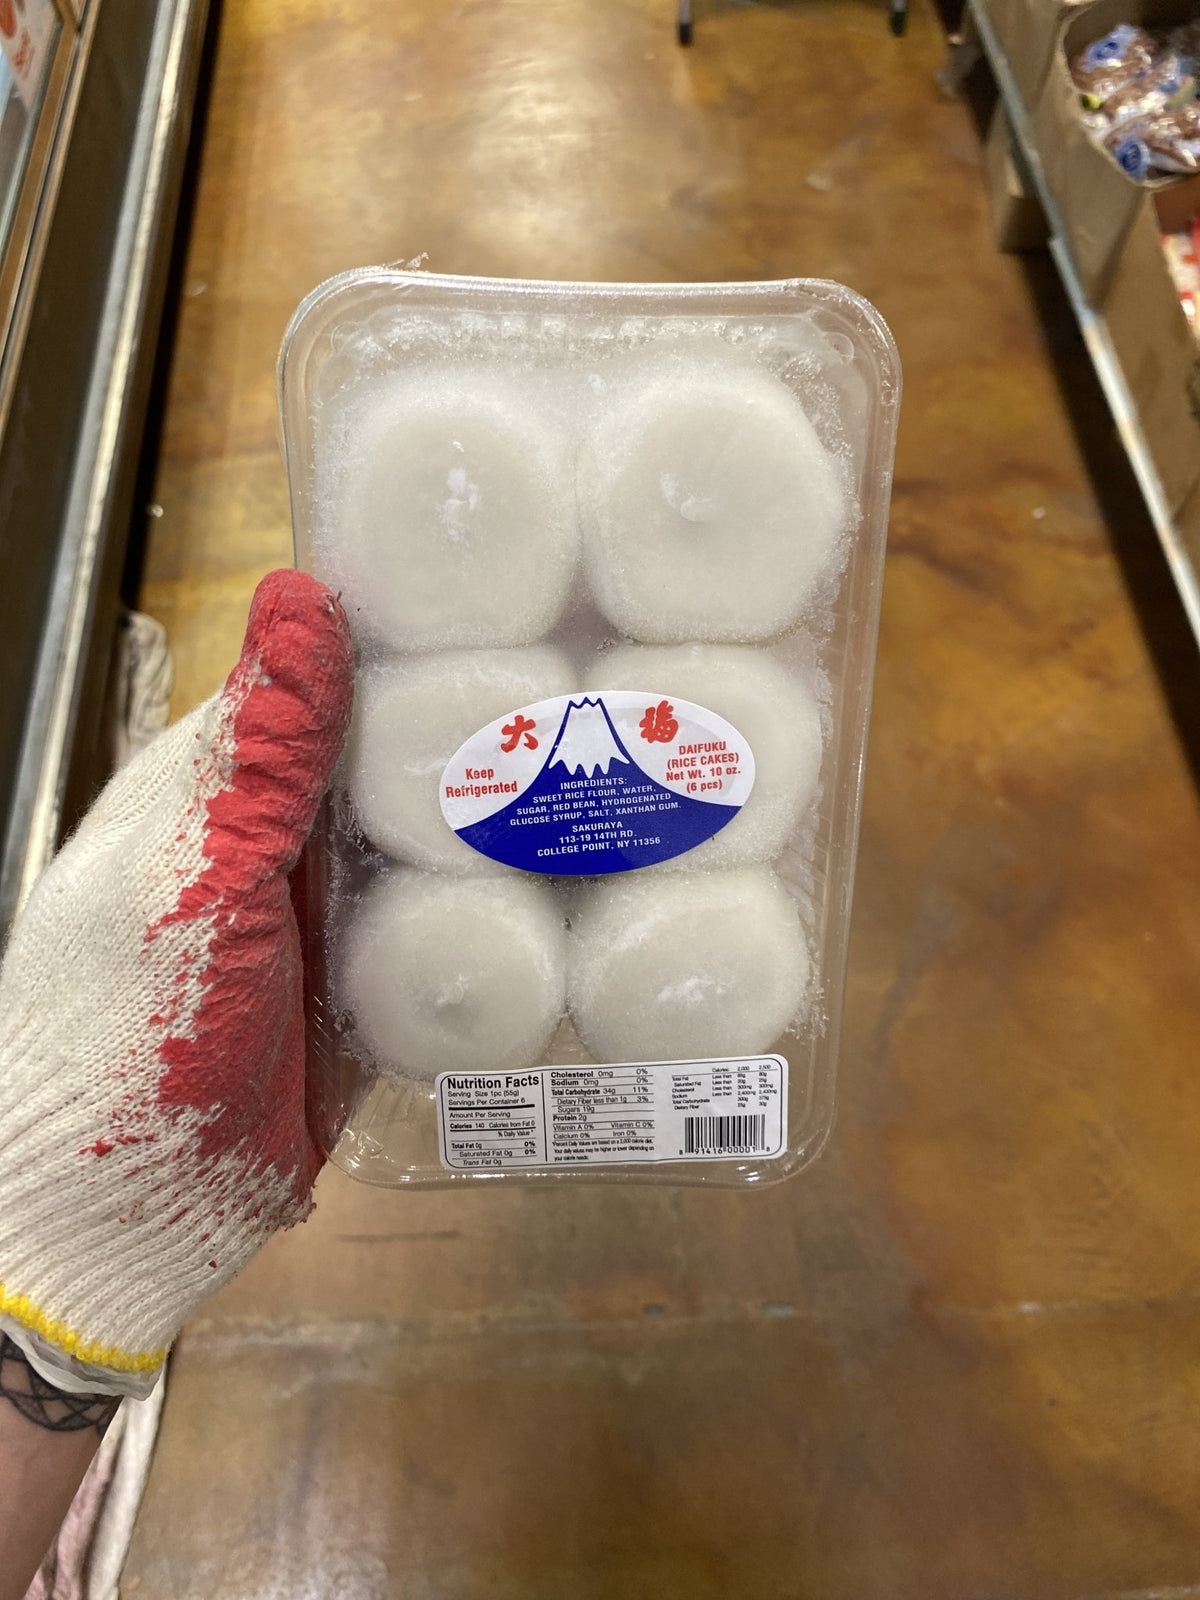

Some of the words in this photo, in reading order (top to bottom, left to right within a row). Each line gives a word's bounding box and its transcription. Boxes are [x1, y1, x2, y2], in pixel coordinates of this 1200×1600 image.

[500, 714, 539, 753] 大
[639, 700, 679, 743] 福
[679, 741, 727, 755] DAIFUKU
[667, 758, 697, 771] (RICE
[700, 752, 740, 765] CAKES)
[465, 768, 494, 780] Keep
[666, 771, 684, 781] Net
[687, 770, 706, 779] Wt.
[709, 767, 722, 777] 10
[725, 767, 741, 775] oz.
[445, 780, 518, 798] Refrigerated
[560, 777, 627, 790] INGREDIENTS:
[686, 781, 697, 793] (6
[700, 779, 723, 792] pcs)
[532, 793, 562, 803] SWEET
[565, 791, 585, 800] RICE
[553, 803, 570, 811] RED
[601, 793, 671, 806] HYDROGENATED
[510, 815, 550, 826] GLUCOSE
[615, 804, 656, 815] XANTHAN
[658, 801, 681, 810] GUM.
[572, 821, 623, 832] SAKURAYA
[559, 833, 591, 844] 113-19
[594, 831, 617, 840] 14TH
[620, 830, 637, 838] RD.
[537, 845, 579, 857] COLLEGE
[617, 840, 630, 848] NY
[633, 837, 661, 847] 11356
[597, 1070, 614, 1078] 0mg
[448, 1078, 501, 1089] Nutrition
[505, 1075, 540, 1088] Facts
[583, 1079, 599, 1087] 0mg
[565, 1088, 600, 1096] Carbohydrate
[557, 1098, 576, 1106] Dietary
[557, 1106, 580, 1114] Sugars
